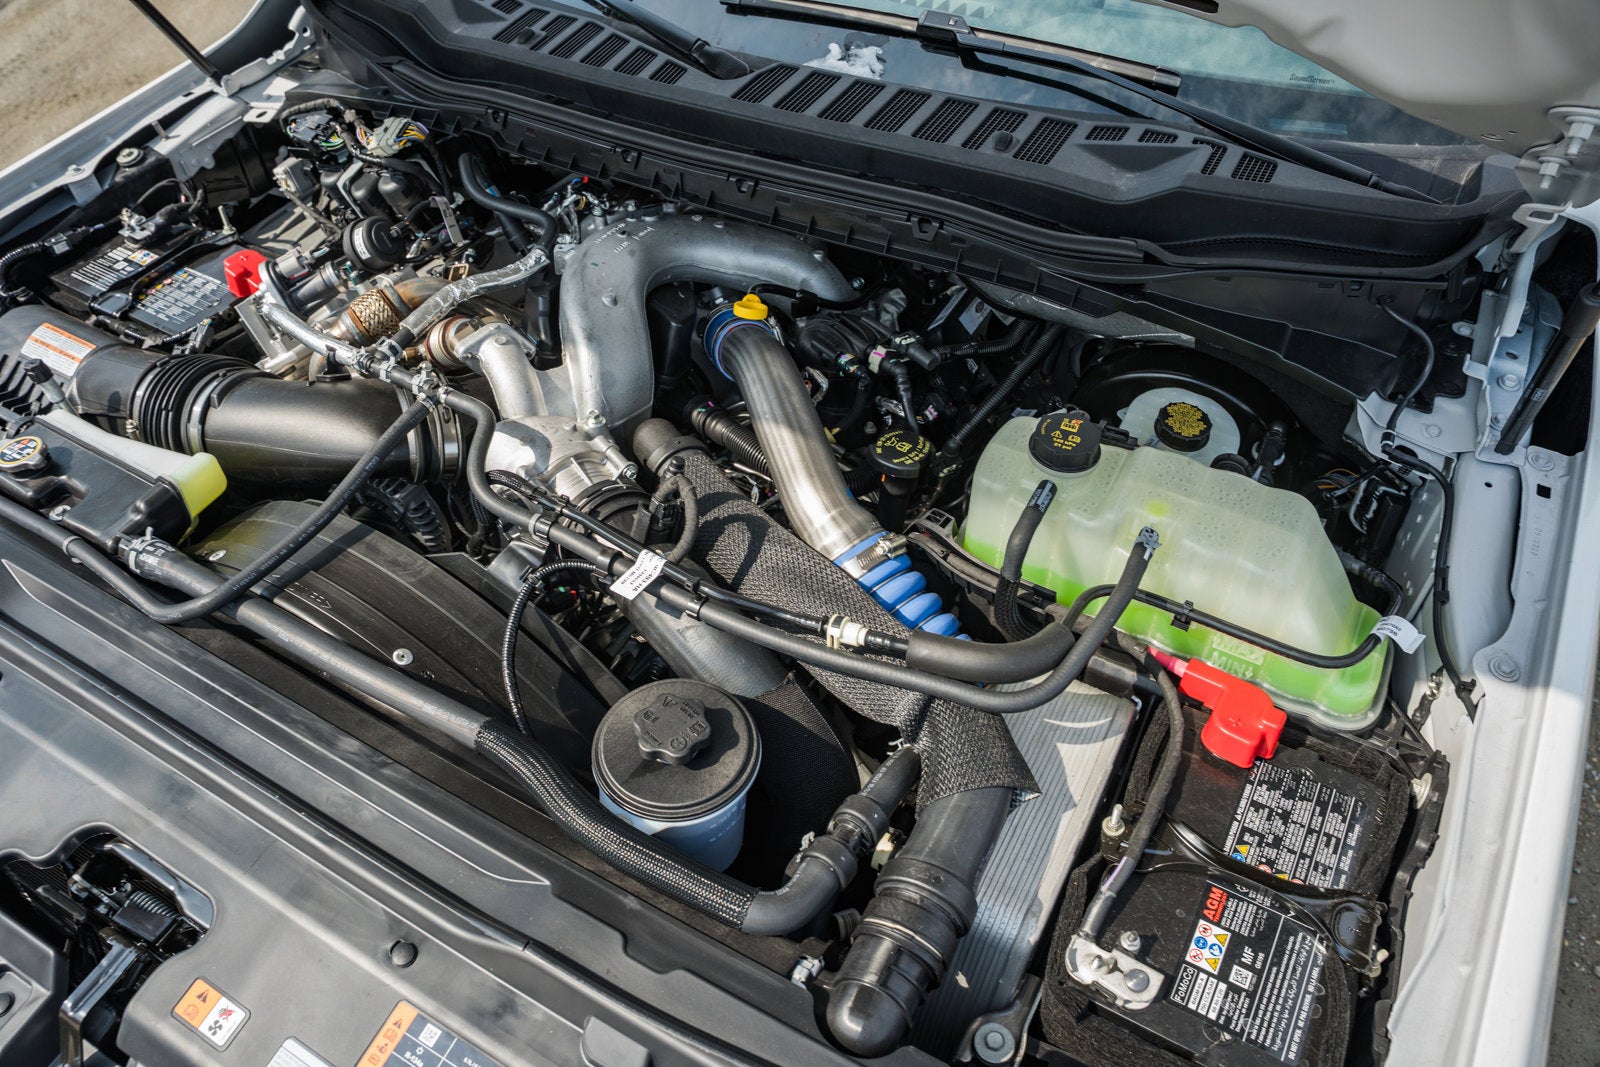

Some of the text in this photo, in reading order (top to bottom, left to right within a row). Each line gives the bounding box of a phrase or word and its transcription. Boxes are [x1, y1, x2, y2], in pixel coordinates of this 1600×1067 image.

[1210, 651, 1246, 678] MIN
[1202, 886, 1222, 920] AGM
[1241, 946, 1254, 964] MF
[1174, 967, 1193, 1002] FoMoCo
